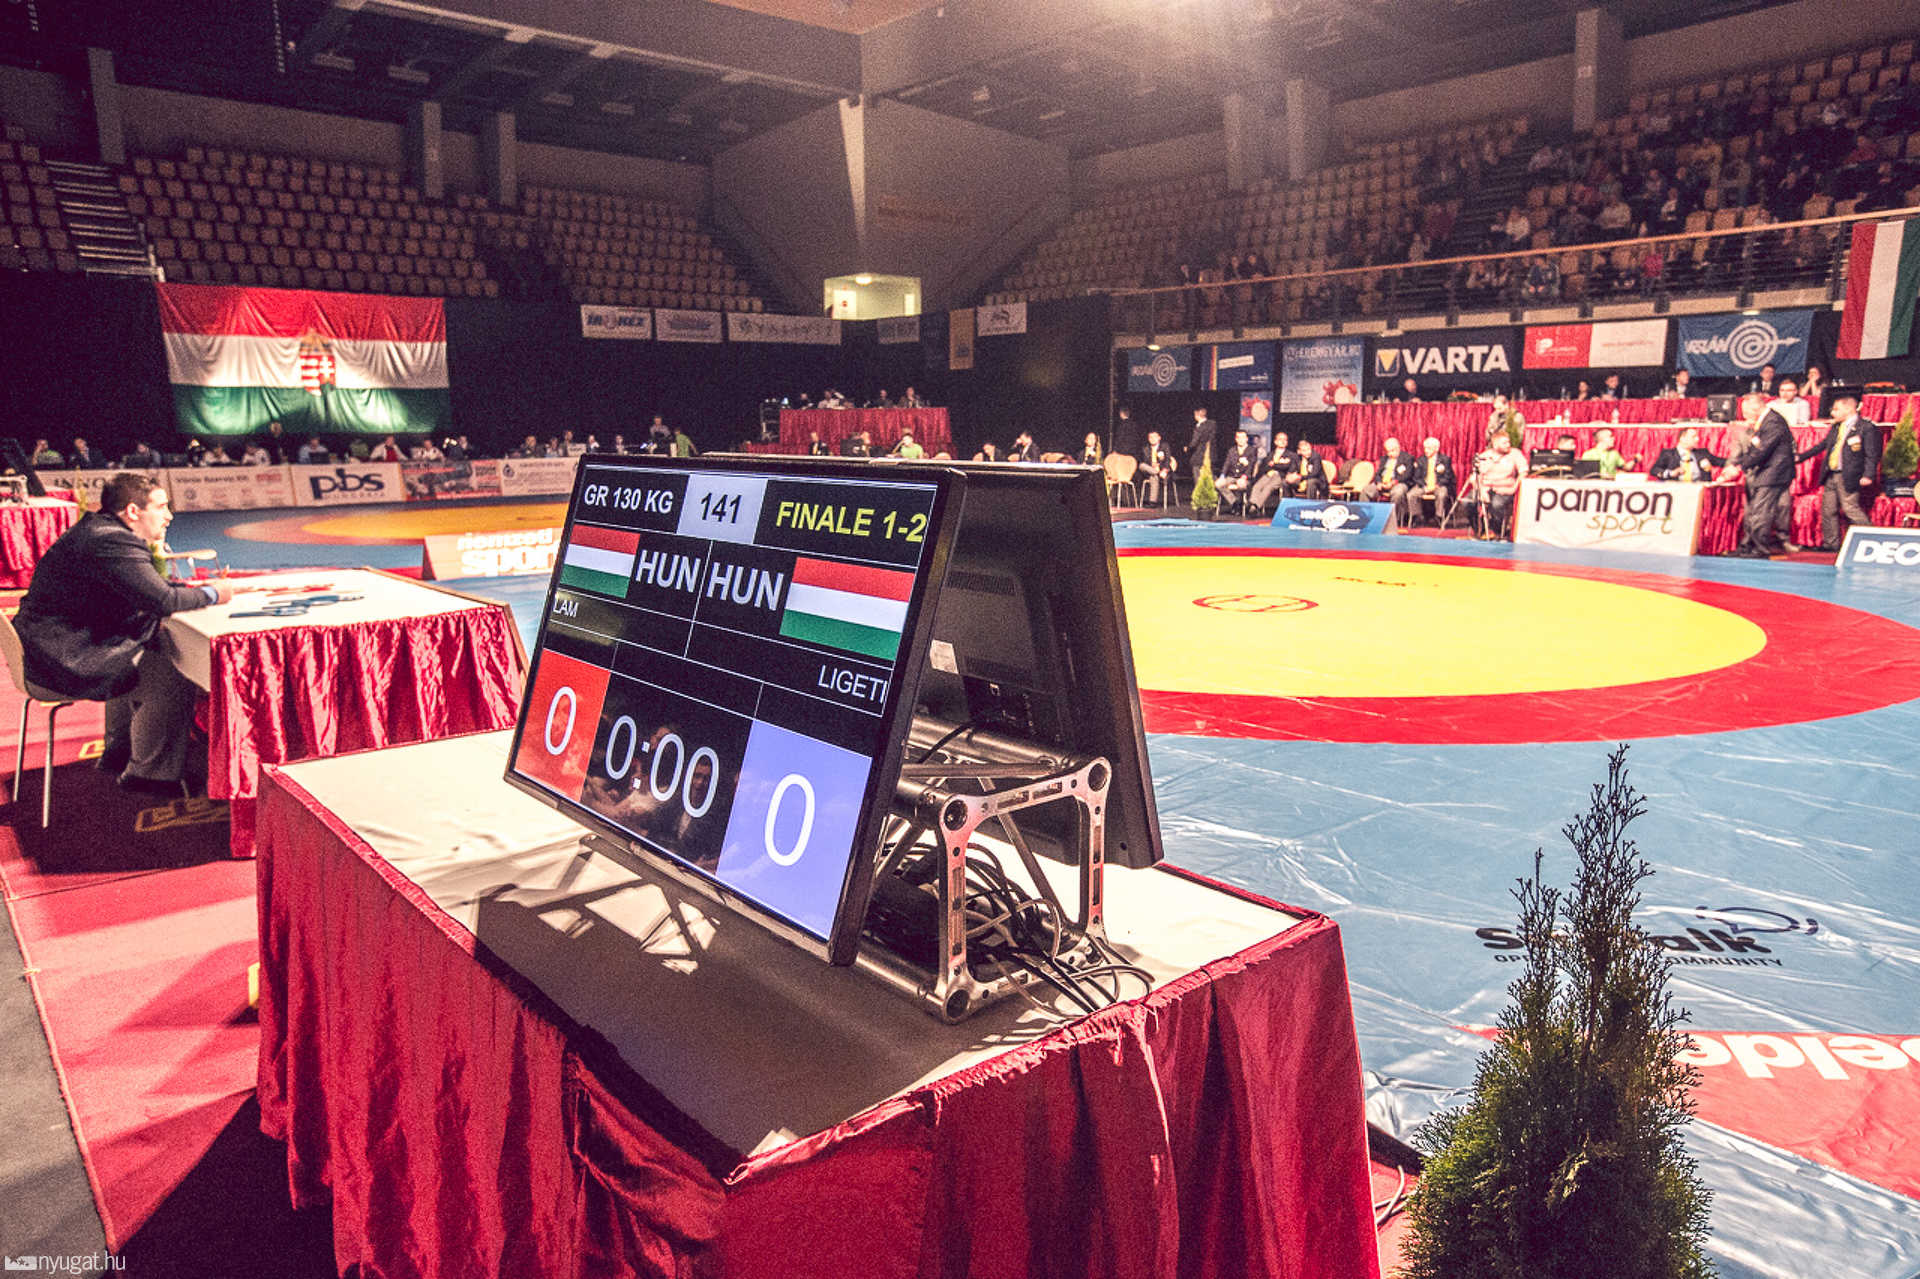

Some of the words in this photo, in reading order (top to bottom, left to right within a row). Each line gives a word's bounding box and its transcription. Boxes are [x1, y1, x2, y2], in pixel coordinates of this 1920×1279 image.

[1401, 344, 1511, 374] VARTA
[309, 468, 385, 500] pbs
[584, 484, 609, 507] GR
[613, 487, 641, 511] 130
[644, 490, 674, 514] KG
[700, 492, 743, 524] 141
[776, 501, 875, 537] FINALE
[882, 511, 928, 543] 1-2
[1534, 487, 1673, 522] pannon
[1586, 512, 1673, 537] sport
[635, 549, 701, 593] HUN
[706, 562, 785, 611] HUN
[817, 664, 888, 704] LIGETI
[545, 686, 577, 755] 0
[605, 715, 719, 818] 0:00
[764, 773, 816, 866] 0
